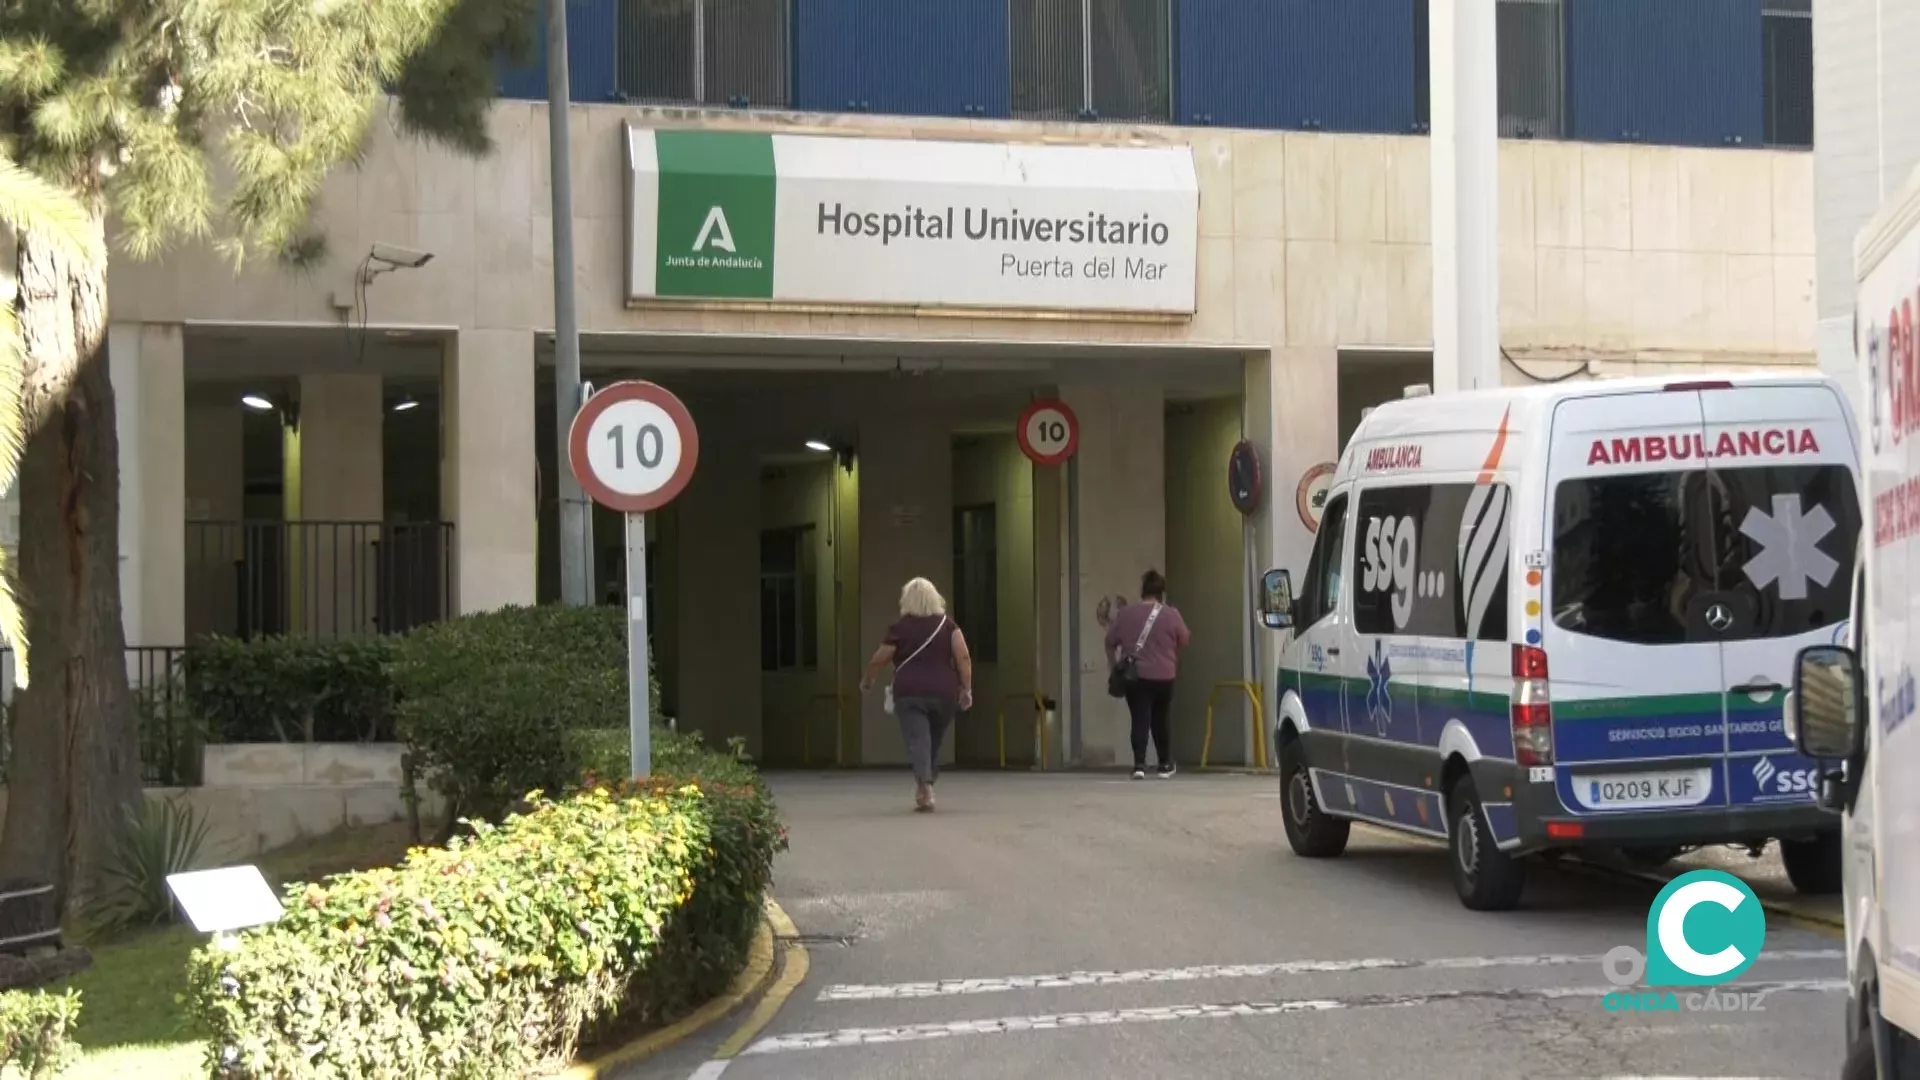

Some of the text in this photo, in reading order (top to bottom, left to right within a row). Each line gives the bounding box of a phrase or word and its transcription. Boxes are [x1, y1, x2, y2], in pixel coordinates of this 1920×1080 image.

[817, 202, 1169, 246] Hospital Universitario
[665, 255, 763, 269] Junta de Andalucía
[1001, 253, 1168, 280] Puerta del Mar
[1038, 421, 1065, 443] 10
[607, 423, 664, 470] 10
[1365, 445, 1423, 471] AMBULANCIA
[1587, 429, 1820, 466] AMBULANCIA
[1608, 728, 1665, 742] SERVICIOS
[1603, 777, 1694, 800] 0209 KJF
